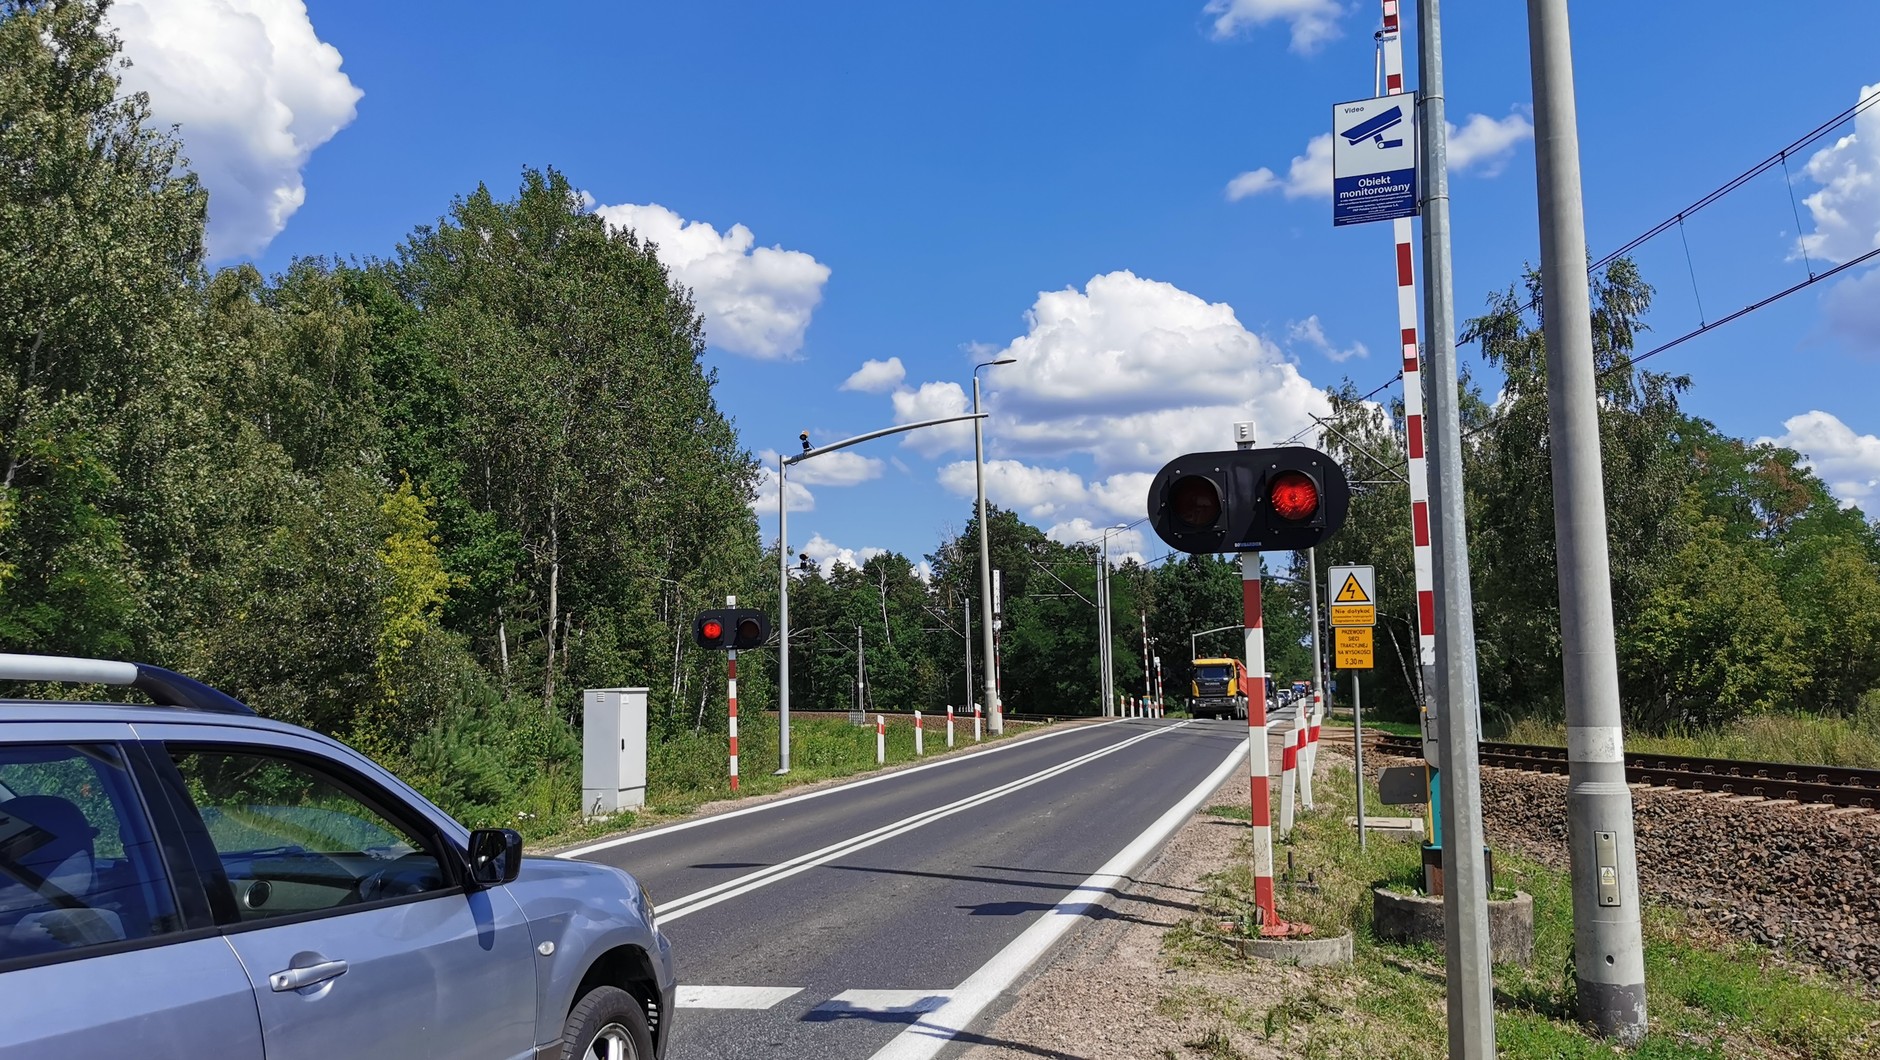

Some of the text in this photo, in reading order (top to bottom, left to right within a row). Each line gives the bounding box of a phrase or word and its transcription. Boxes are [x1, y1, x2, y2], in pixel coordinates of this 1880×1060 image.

[1344, 106, 1365, 114] Video
[1358, 175, 1391, 187] Obiekt
[1340, 183, 1410, 199] monitorowany
